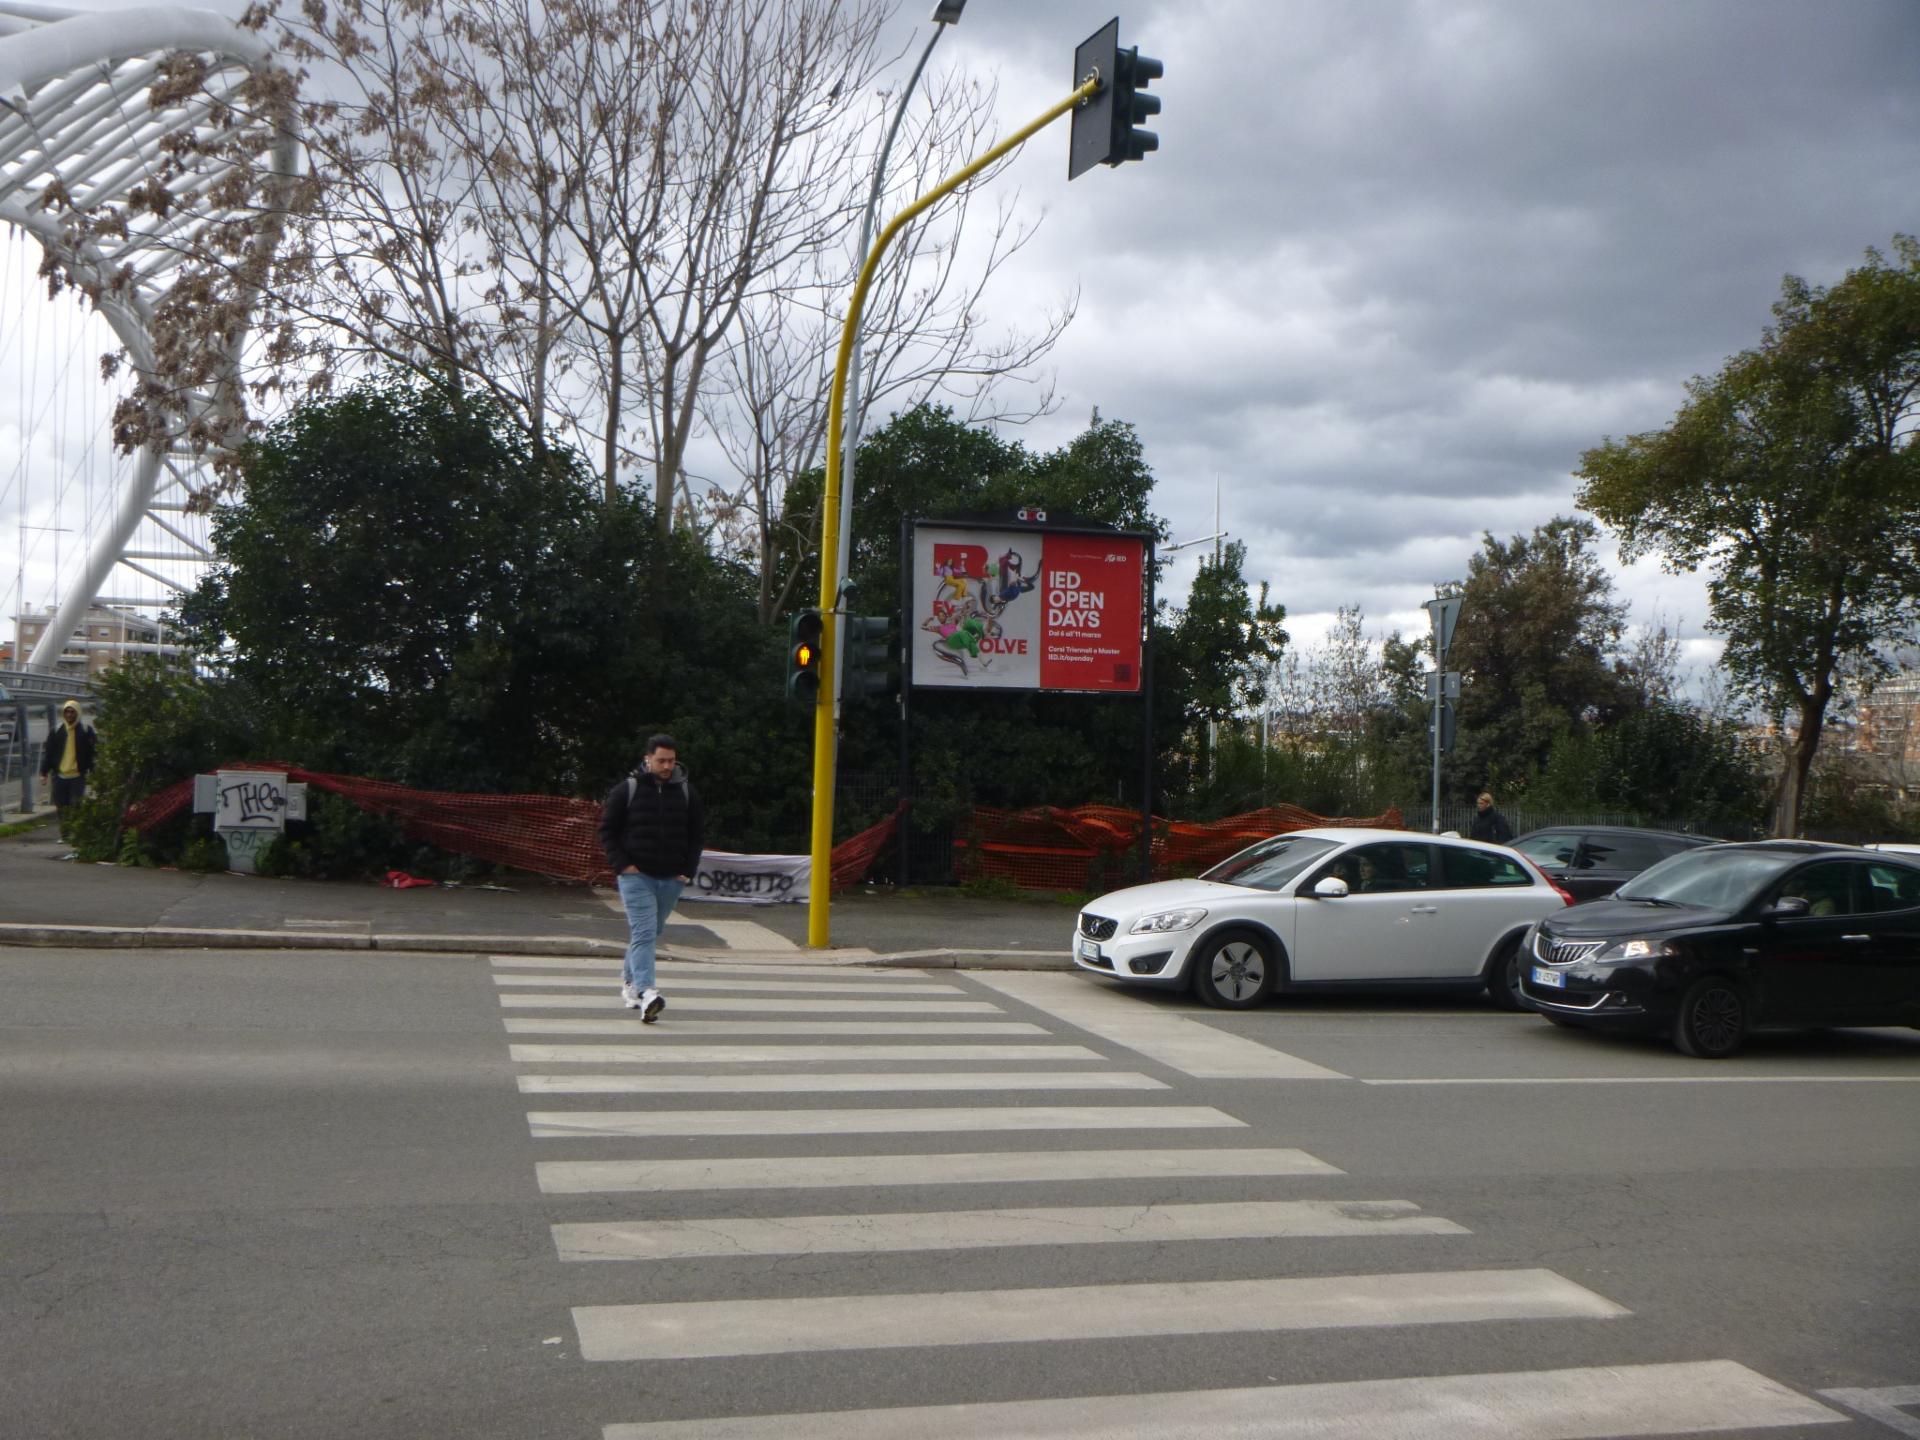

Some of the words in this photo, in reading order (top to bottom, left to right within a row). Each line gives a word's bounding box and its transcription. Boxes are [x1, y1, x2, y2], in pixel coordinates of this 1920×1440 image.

[1049, 570, 1081, 590] IED
[1049, 590, 1105, 609] OPEN
[1048, 608, 1101, 629] DAYS
[978, 639, 1028, 655] OLVE
[1048, 646, 1065, 654] Corsi
[684, 870, 793, 893] ORBETTO
